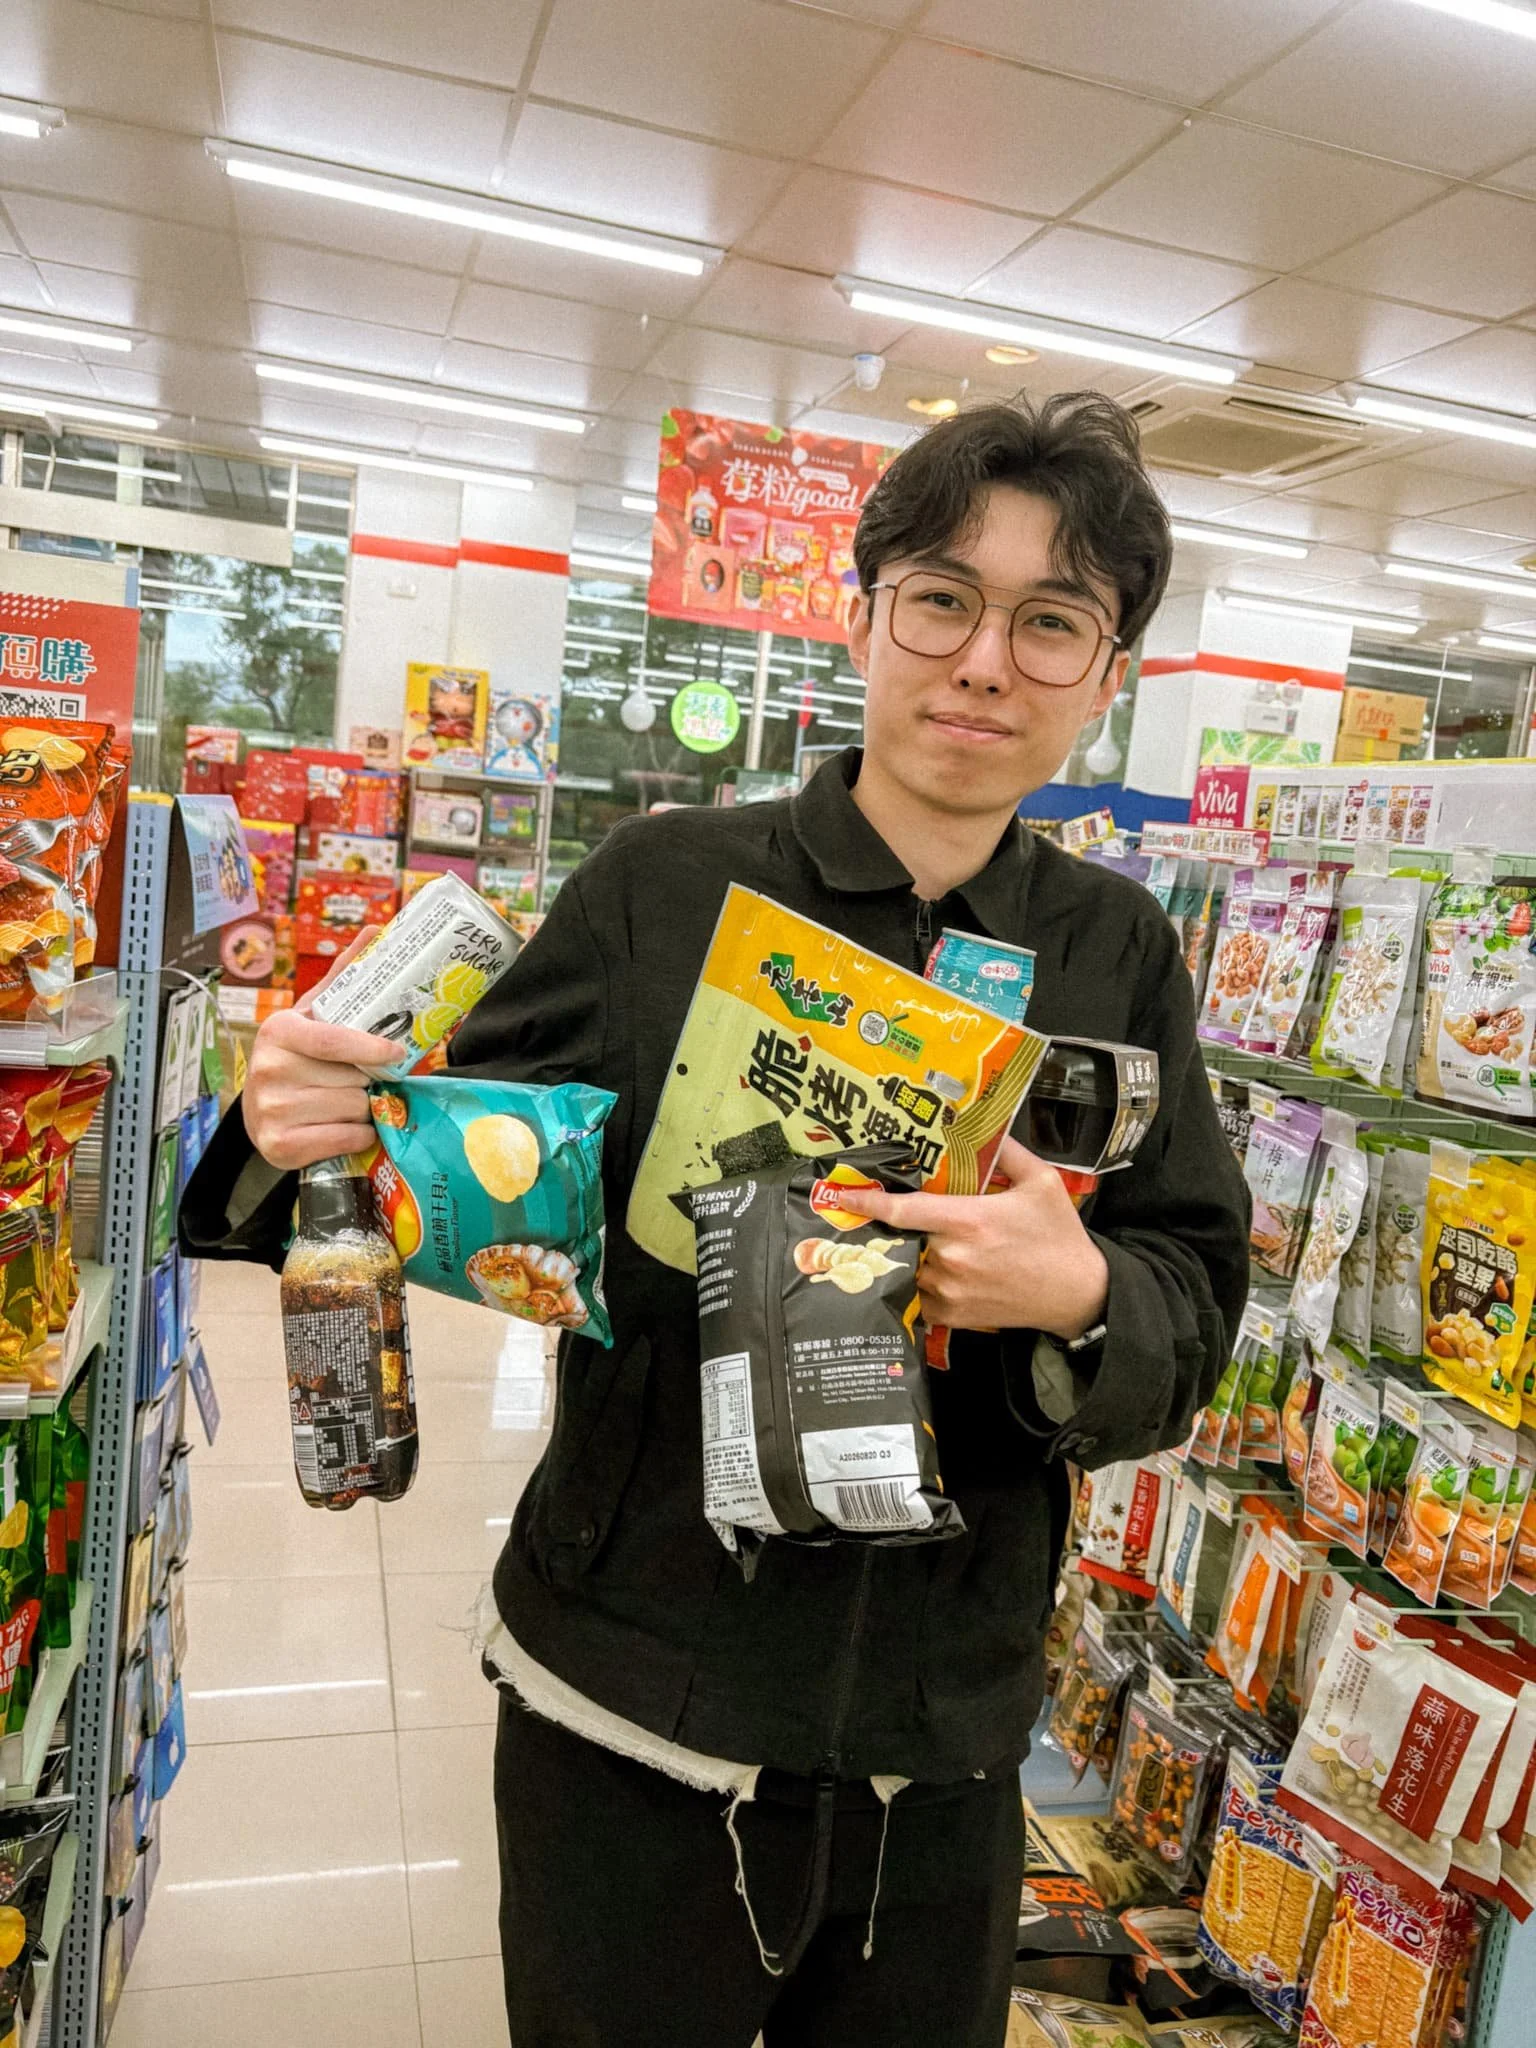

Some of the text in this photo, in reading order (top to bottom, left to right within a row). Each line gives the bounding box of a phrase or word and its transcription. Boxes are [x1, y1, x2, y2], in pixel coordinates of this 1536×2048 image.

[1199, 779, 1238, 815] Viva
[453, 920, 504, 955] ZERO
[449, 942, 506, 976] SUGAR
[758, 959, 855, 1027] 元本山
[930, 967, 1004, 998] ほろよい
[748, 1028, 945, 1176] 脆烤海苔
[1454, 1256, 1497, 1294] 堅果
[879, 1449, 892, 1459] Q3
[1385, 1695, 1450, 1821] 蒜味落花生
